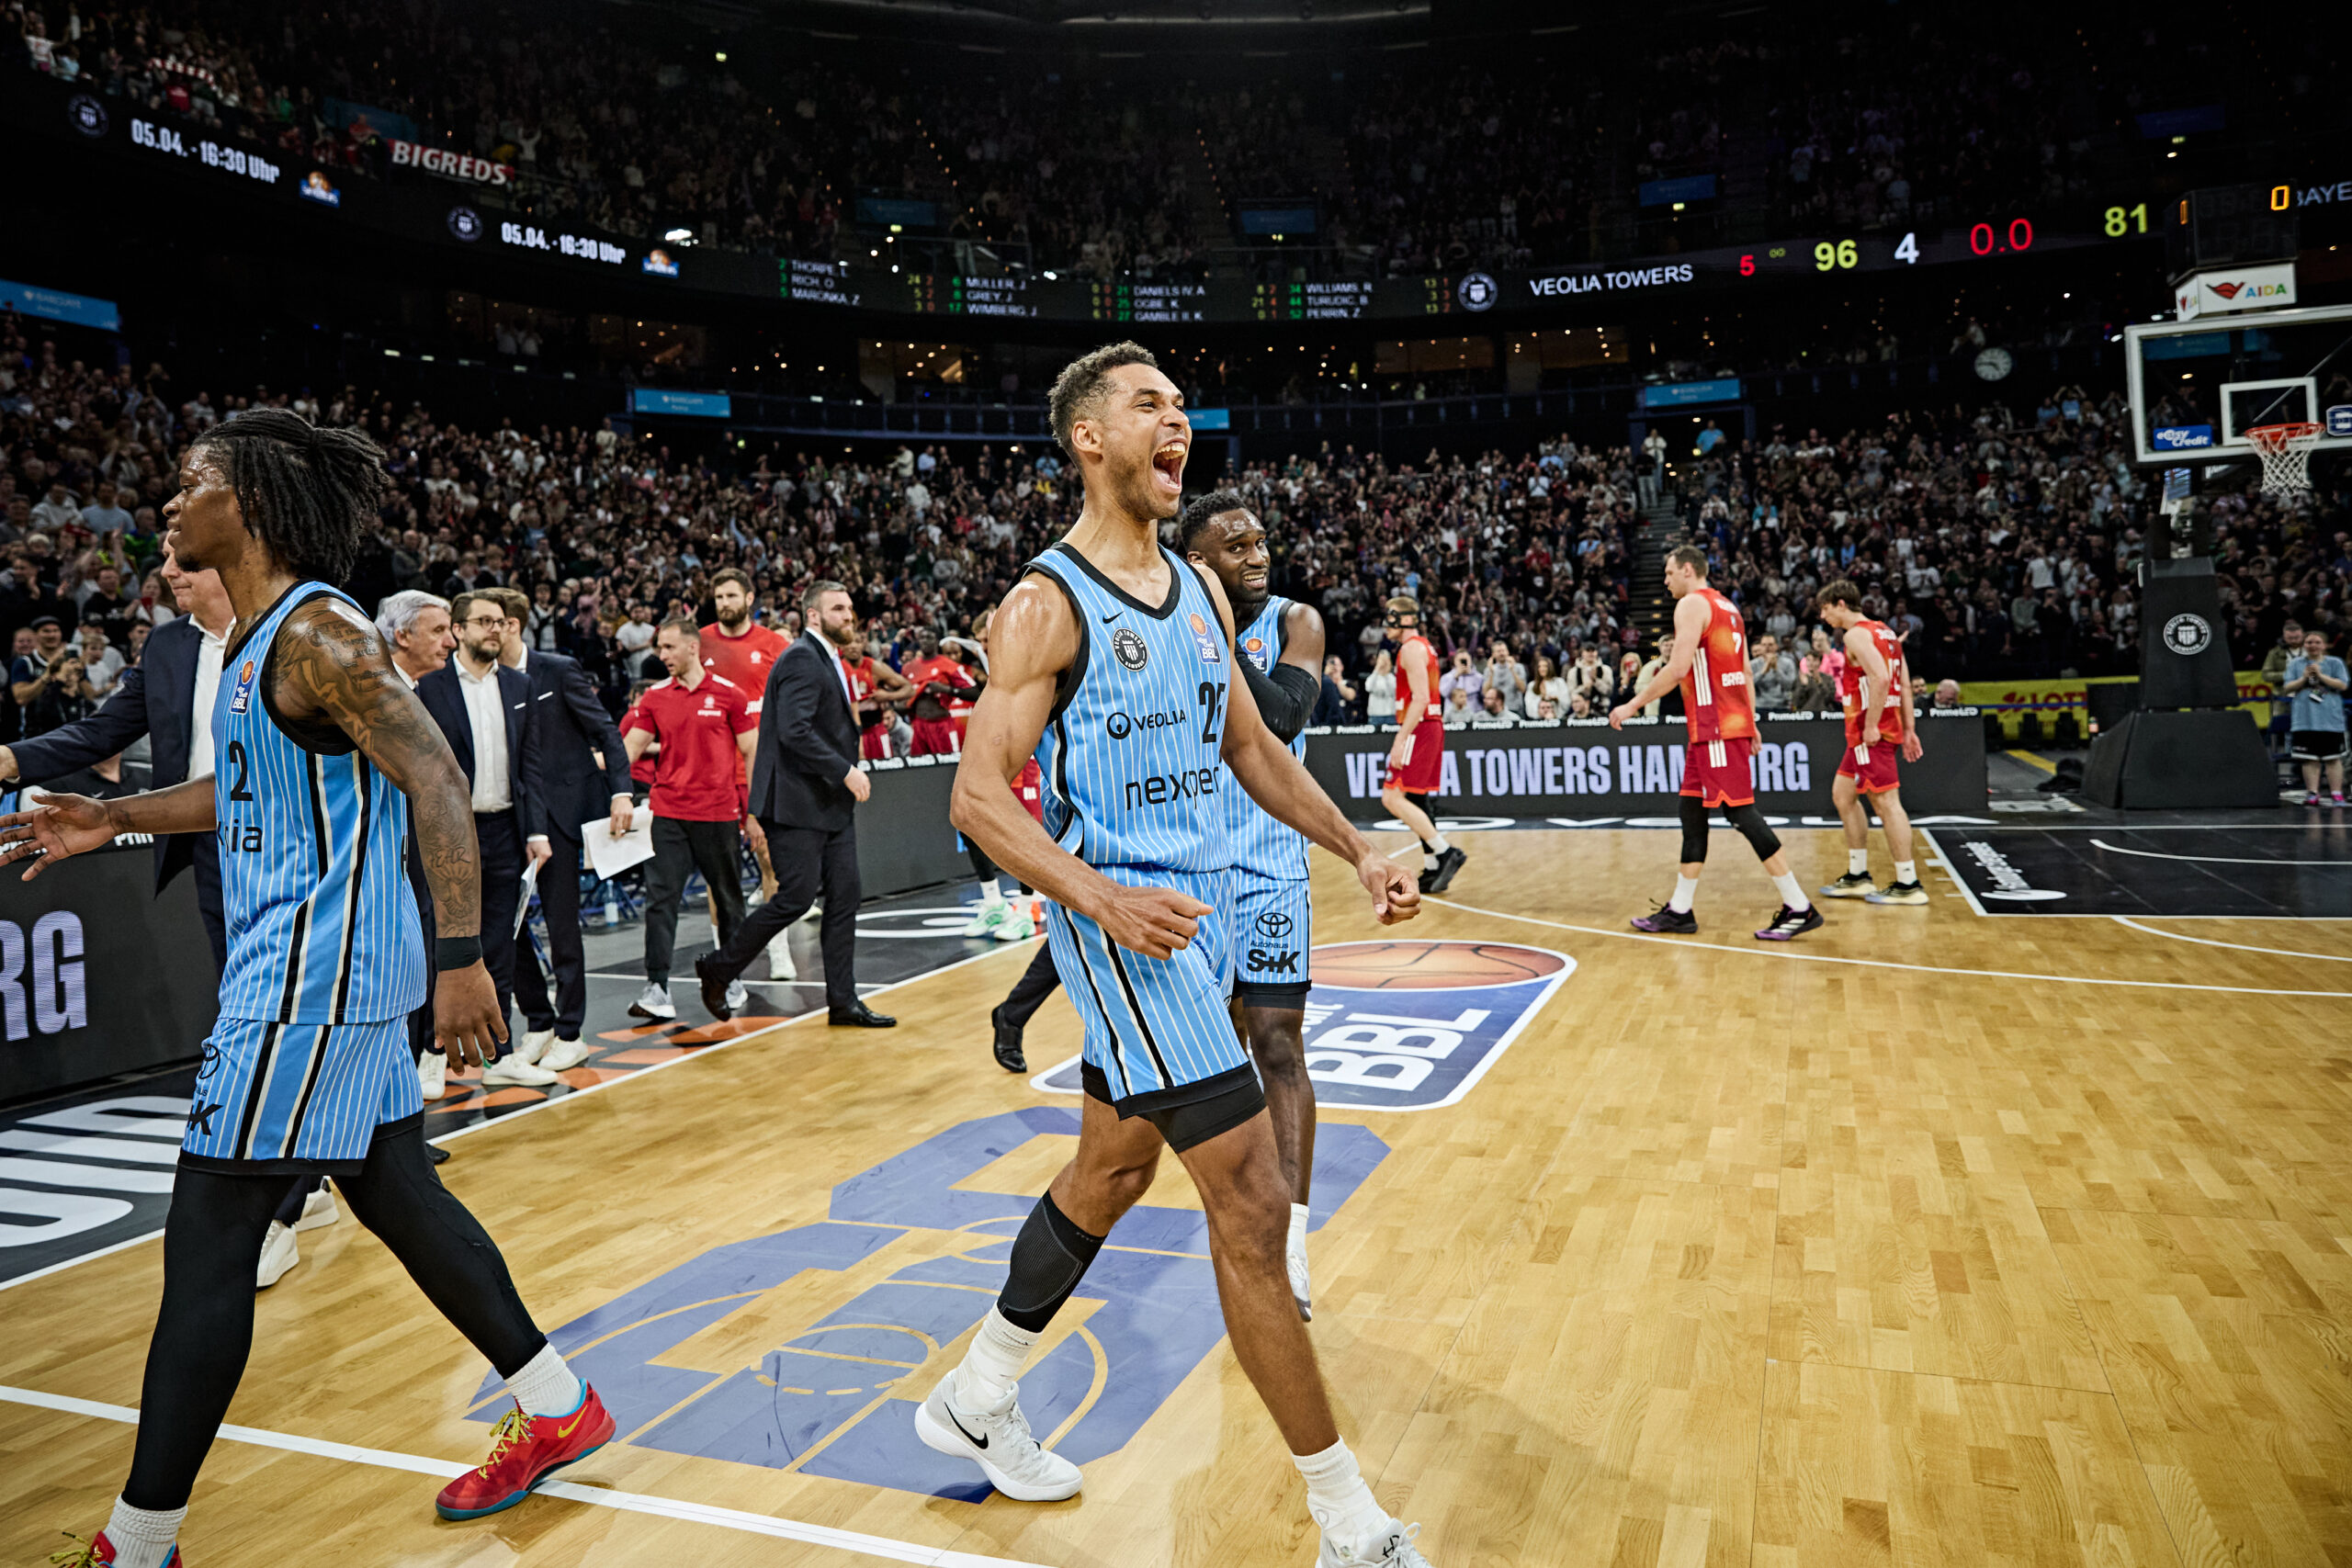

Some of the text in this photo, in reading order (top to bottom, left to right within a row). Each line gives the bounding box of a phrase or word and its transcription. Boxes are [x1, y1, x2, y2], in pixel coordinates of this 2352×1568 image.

[130, 118, 188, 157] 05.04.
[199, 140, 246, 175] 16:30
[248, 154, 279, 184] Uhr
[391, 140, 507, 185] BIGREDS
[2271, 186, 2290, 210] 0
[2104, 203, 2148, 237] 81
[501, 221, 550, 251] 05.04.
[559, 234, 597, 260] 16:30
[598, 242, 626, 265] Uhr
[1894, 231, 1920, 265] 4
[1970, 218, 2033, 255] 0.0
[1739, 254, 1756, 276] 5
[1814, 239, 1859, 271] 96
[1530, 264, 1692, 296] VEOLIA TOWERS
[2245, 283, 2287, 299] AIDA
[2172, 434, 2210, 447] Credit
[1202, 648, 1218, 659] BBL
[1732, 631, 1742, 654] 7
[232, 697, 246, 710] BBL
[2031, 691, 2087, 710] LOTT
[1134, 709, 1187, 731] VEOLIA
[1336, 725, 1375, 735] PrimeLED
[1472, 719, 1514, 730] PrimeLED
[1519, 718, 1561, 729] PrimeLED
[1566, 716, 1609, 728] PrimeLED
[1768, 710, 1815, 721] PrimeLED
[1929, 706, 1979, 718] PrimeLED
[229, 740, 253, 801] 2
[1345, 741, 1811, 798] VEA TOWERS HARG
[1125, 766, 1219, 811] nexper
[1250, 940, 1288, 949] Autohaus
[1247, 949, 1301, 975] S+K
[1304, 1009, 1492, 1091] BBL
